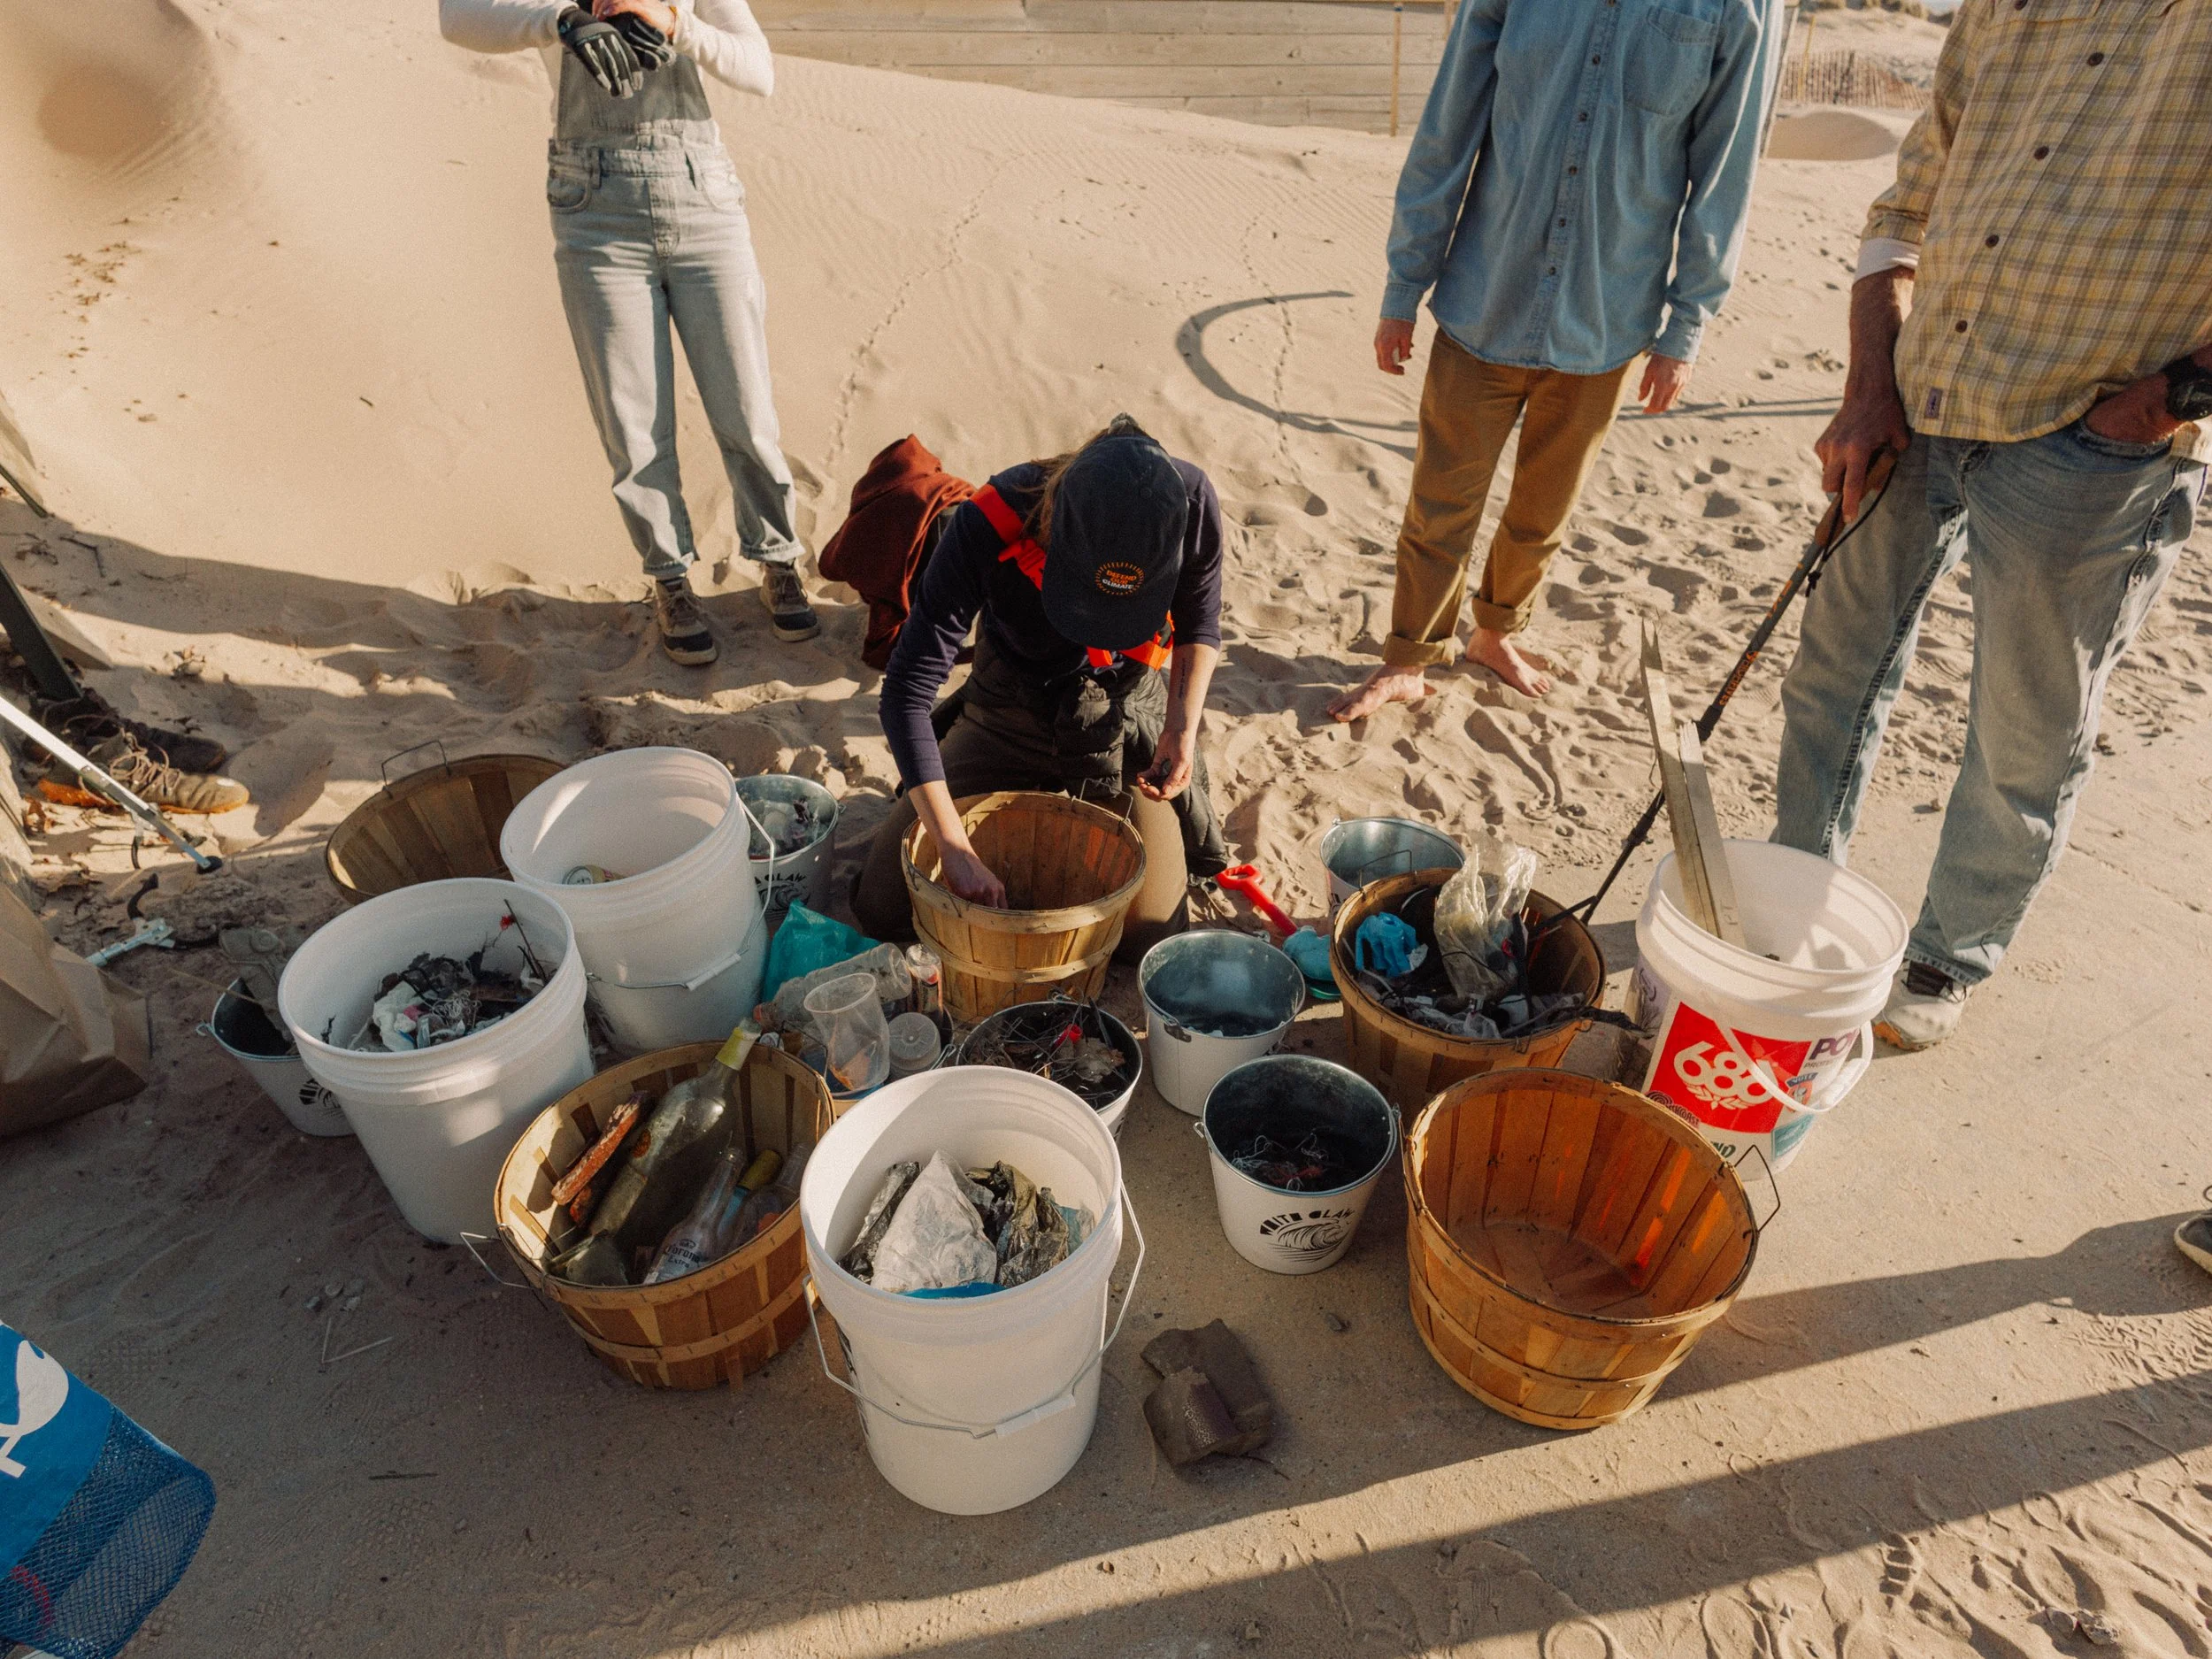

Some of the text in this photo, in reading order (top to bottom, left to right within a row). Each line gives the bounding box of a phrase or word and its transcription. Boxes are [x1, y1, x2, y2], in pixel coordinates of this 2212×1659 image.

[1107, 570, 1137, 581] DEFEND
[1102, 579, 1134, 589] CLIMATE
[667, 1245, 701, 1263] Corona
[668, 1255, 690, 1269] Extra
